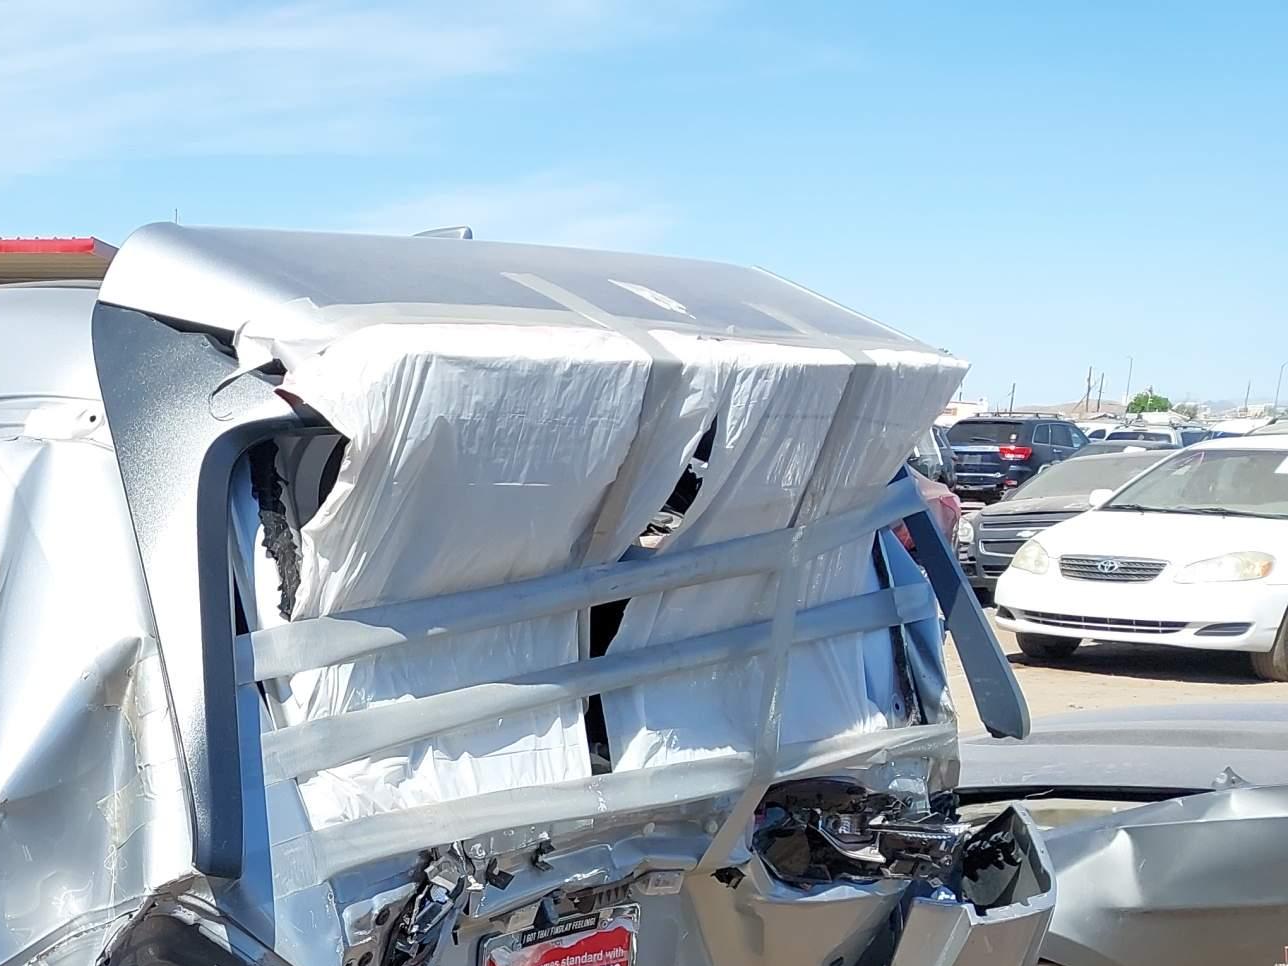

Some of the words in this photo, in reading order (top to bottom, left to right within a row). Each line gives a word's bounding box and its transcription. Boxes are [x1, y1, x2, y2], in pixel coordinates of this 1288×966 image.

[526, 931, 537, 943] GOT
[537, 928, 550, 939] THAT
[561, 950, 603, 966] standard
[606, 947, 624, 959] with
